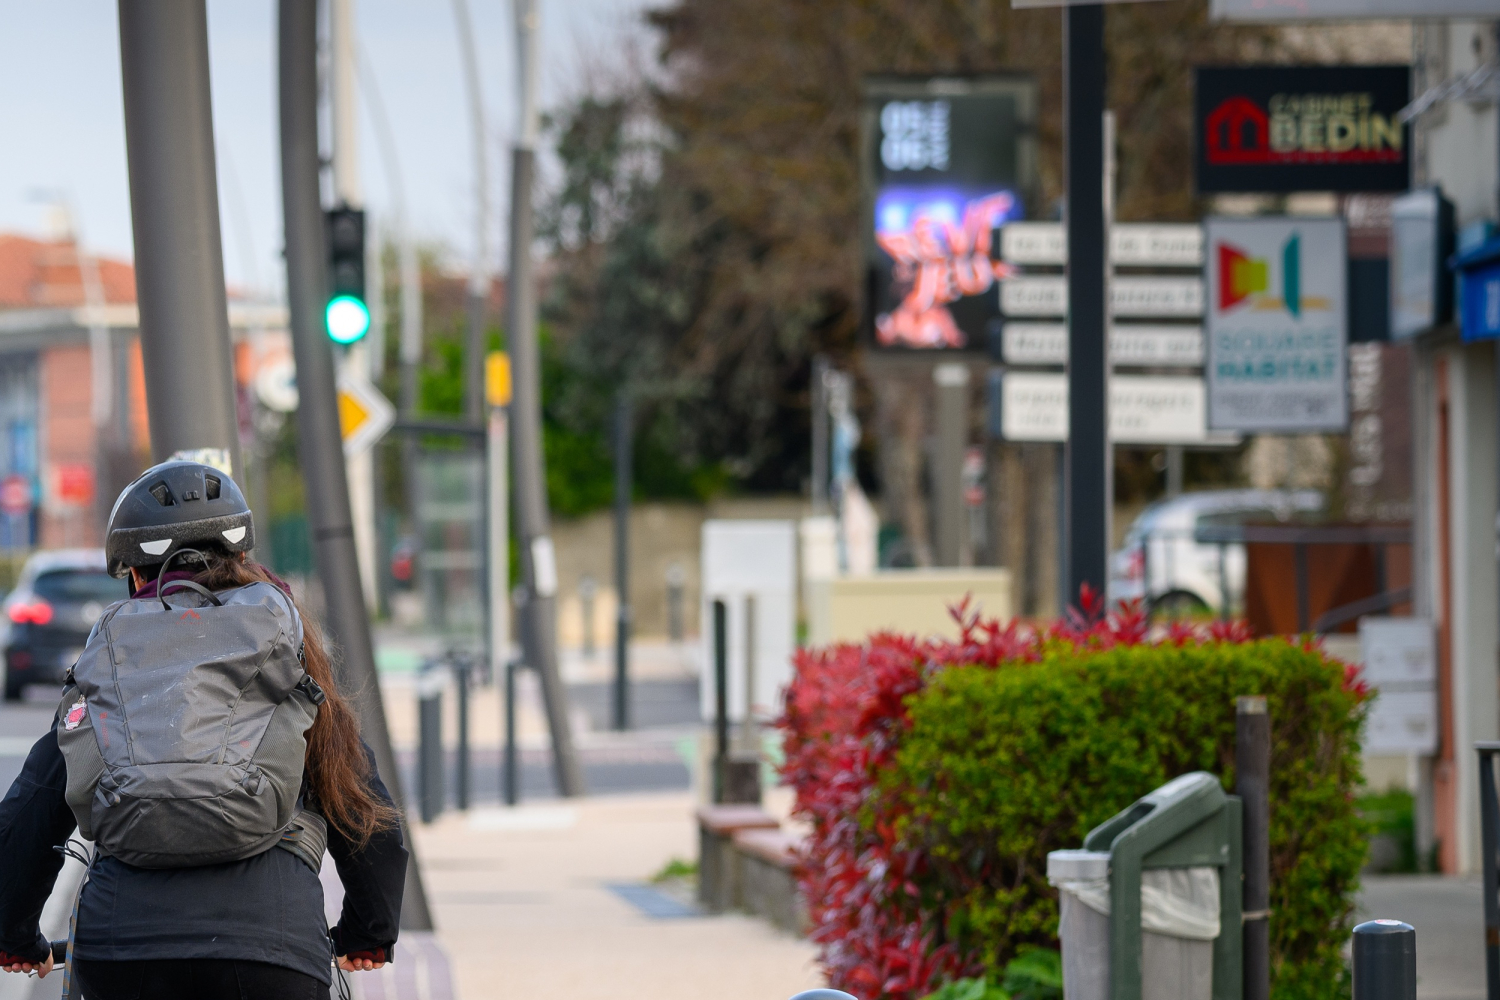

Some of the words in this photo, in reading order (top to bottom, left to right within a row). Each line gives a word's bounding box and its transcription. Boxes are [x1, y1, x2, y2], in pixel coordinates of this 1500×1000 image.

[1269, 94, 1373, 117] CABINET
[1269, 113, 1404, 150] BEDIN
[1217, 356, 1336, 380] HABITAT
